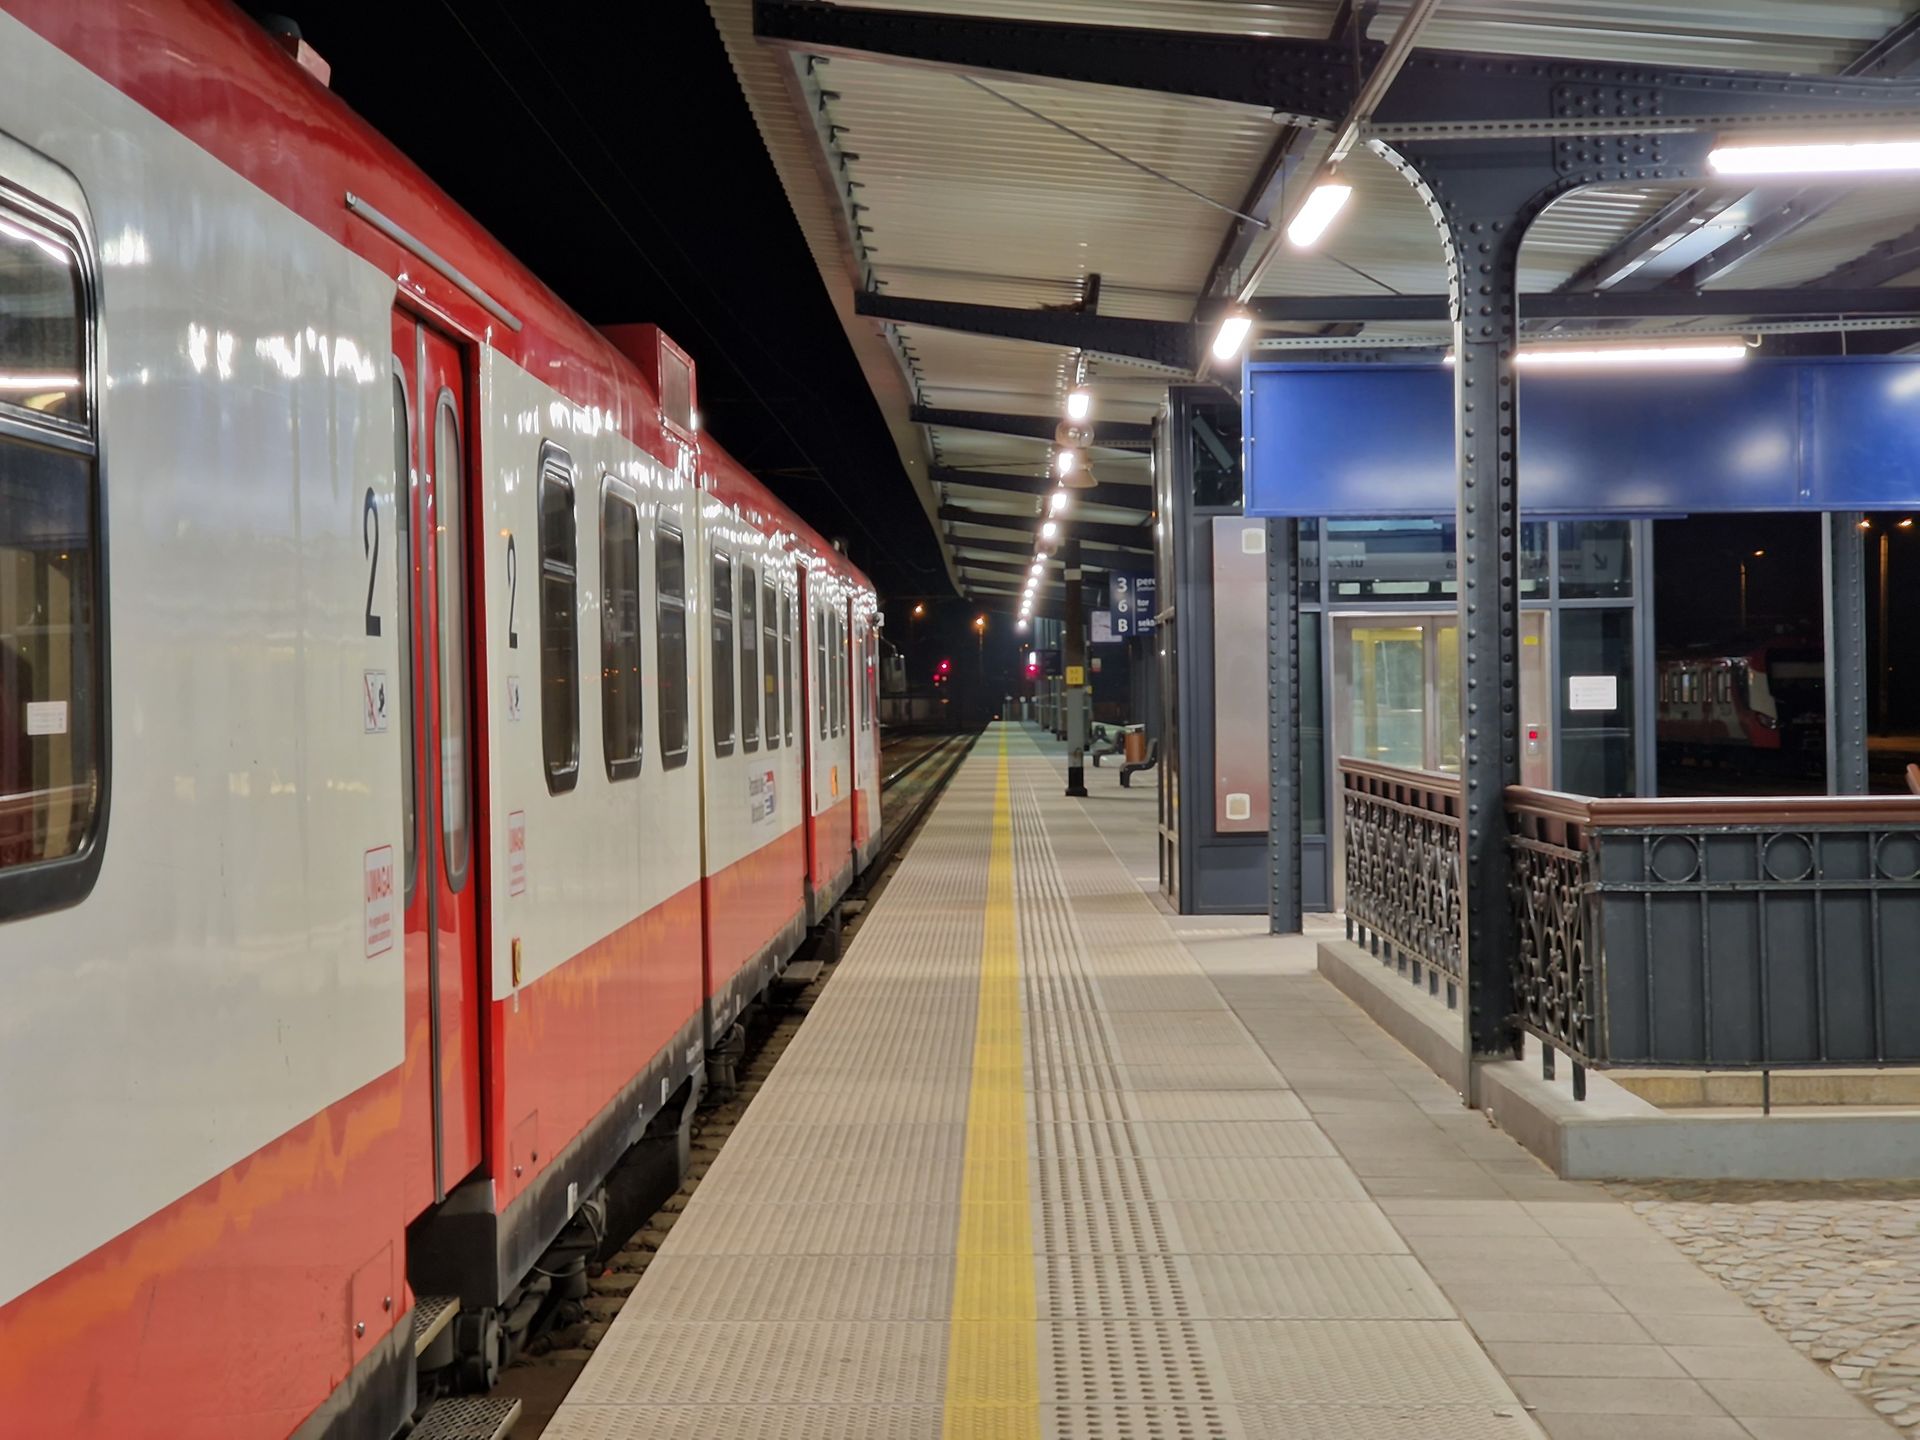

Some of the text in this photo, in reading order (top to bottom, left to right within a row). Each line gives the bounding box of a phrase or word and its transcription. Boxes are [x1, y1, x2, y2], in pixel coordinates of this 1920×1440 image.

[364, 486, 381, 637] 2
[507, 533, 518, 649] 2
[1117, 577, 1128, 593] 3
[1118, 600, 1128, 613] 6
[1118, 619, 1128, 633] B
